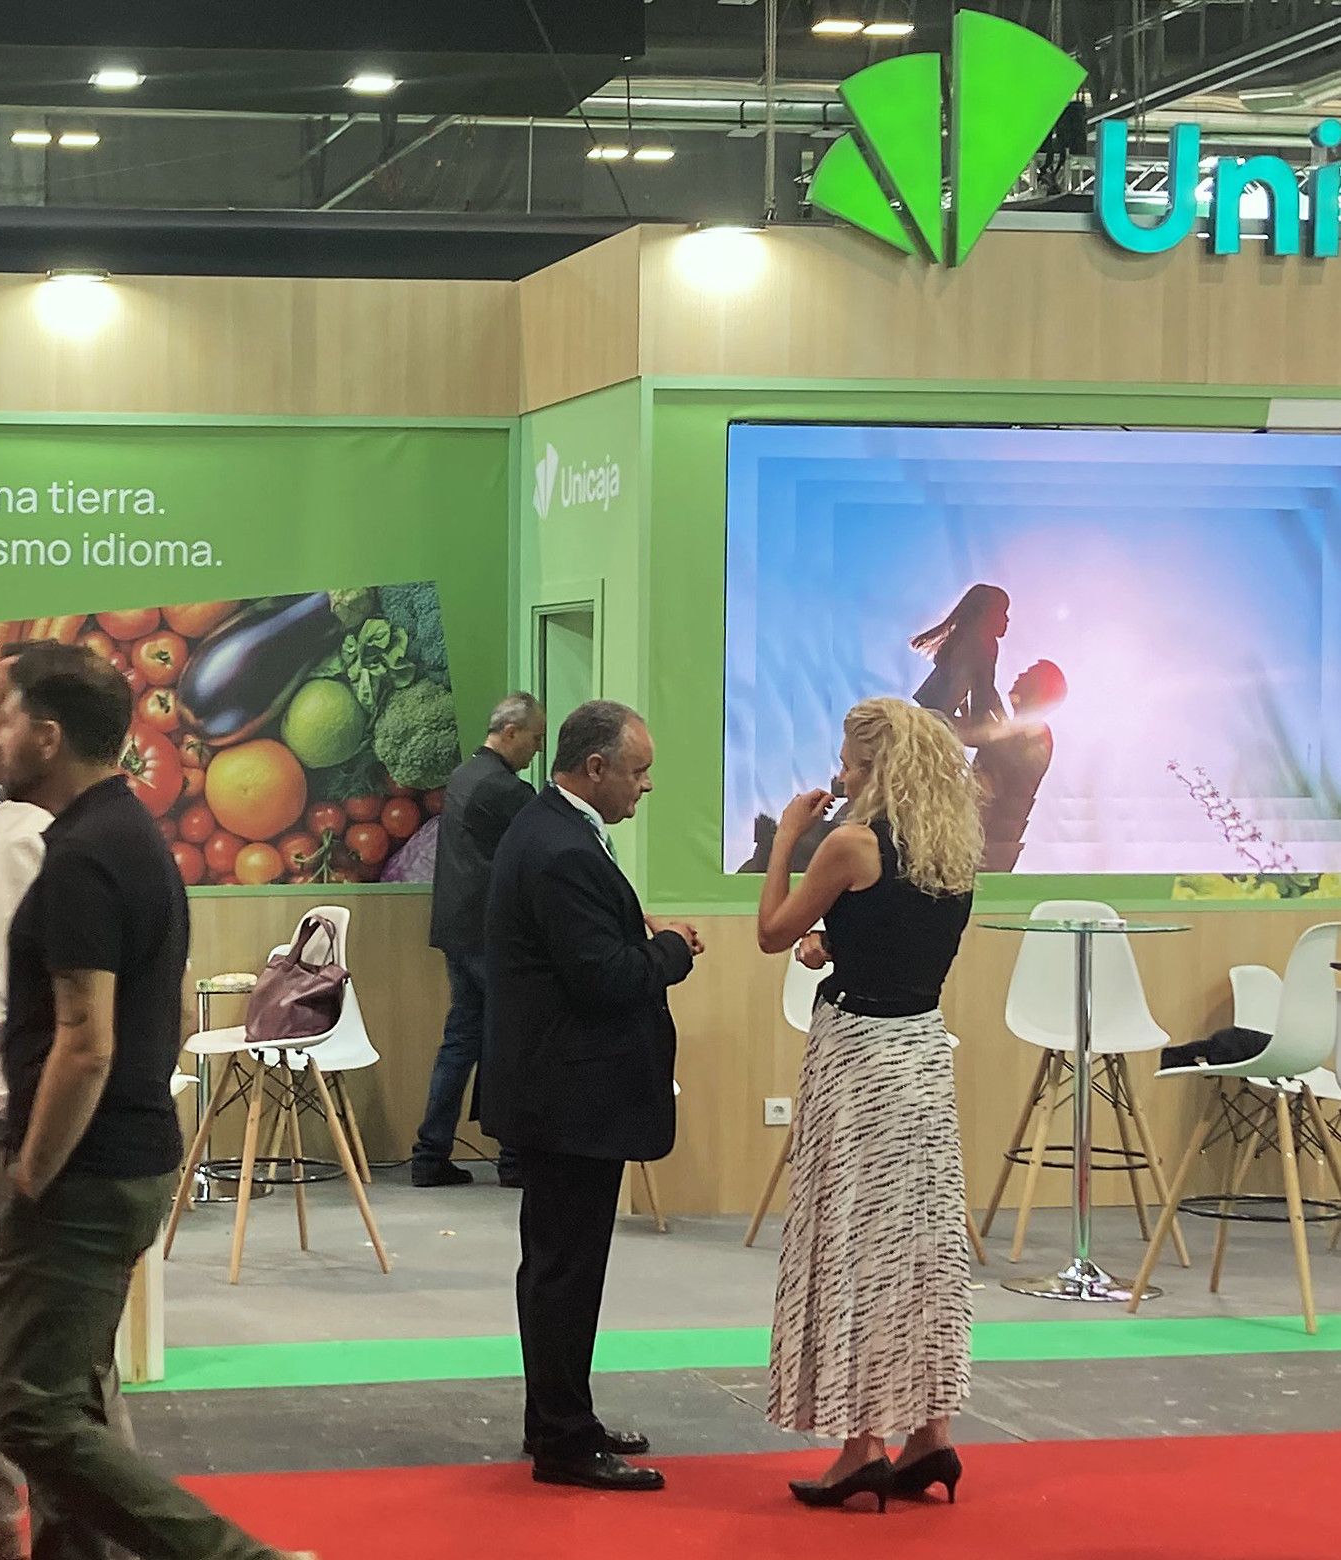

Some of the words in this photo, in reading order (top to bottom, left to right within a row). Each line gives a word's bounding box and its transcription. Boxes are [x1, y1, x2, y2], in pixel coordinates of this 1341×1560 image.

[46, 480, 166, 516] tierra.
[561, 454, 620, 512] Unicaja
[82, 532, 223, 568] idioma.
